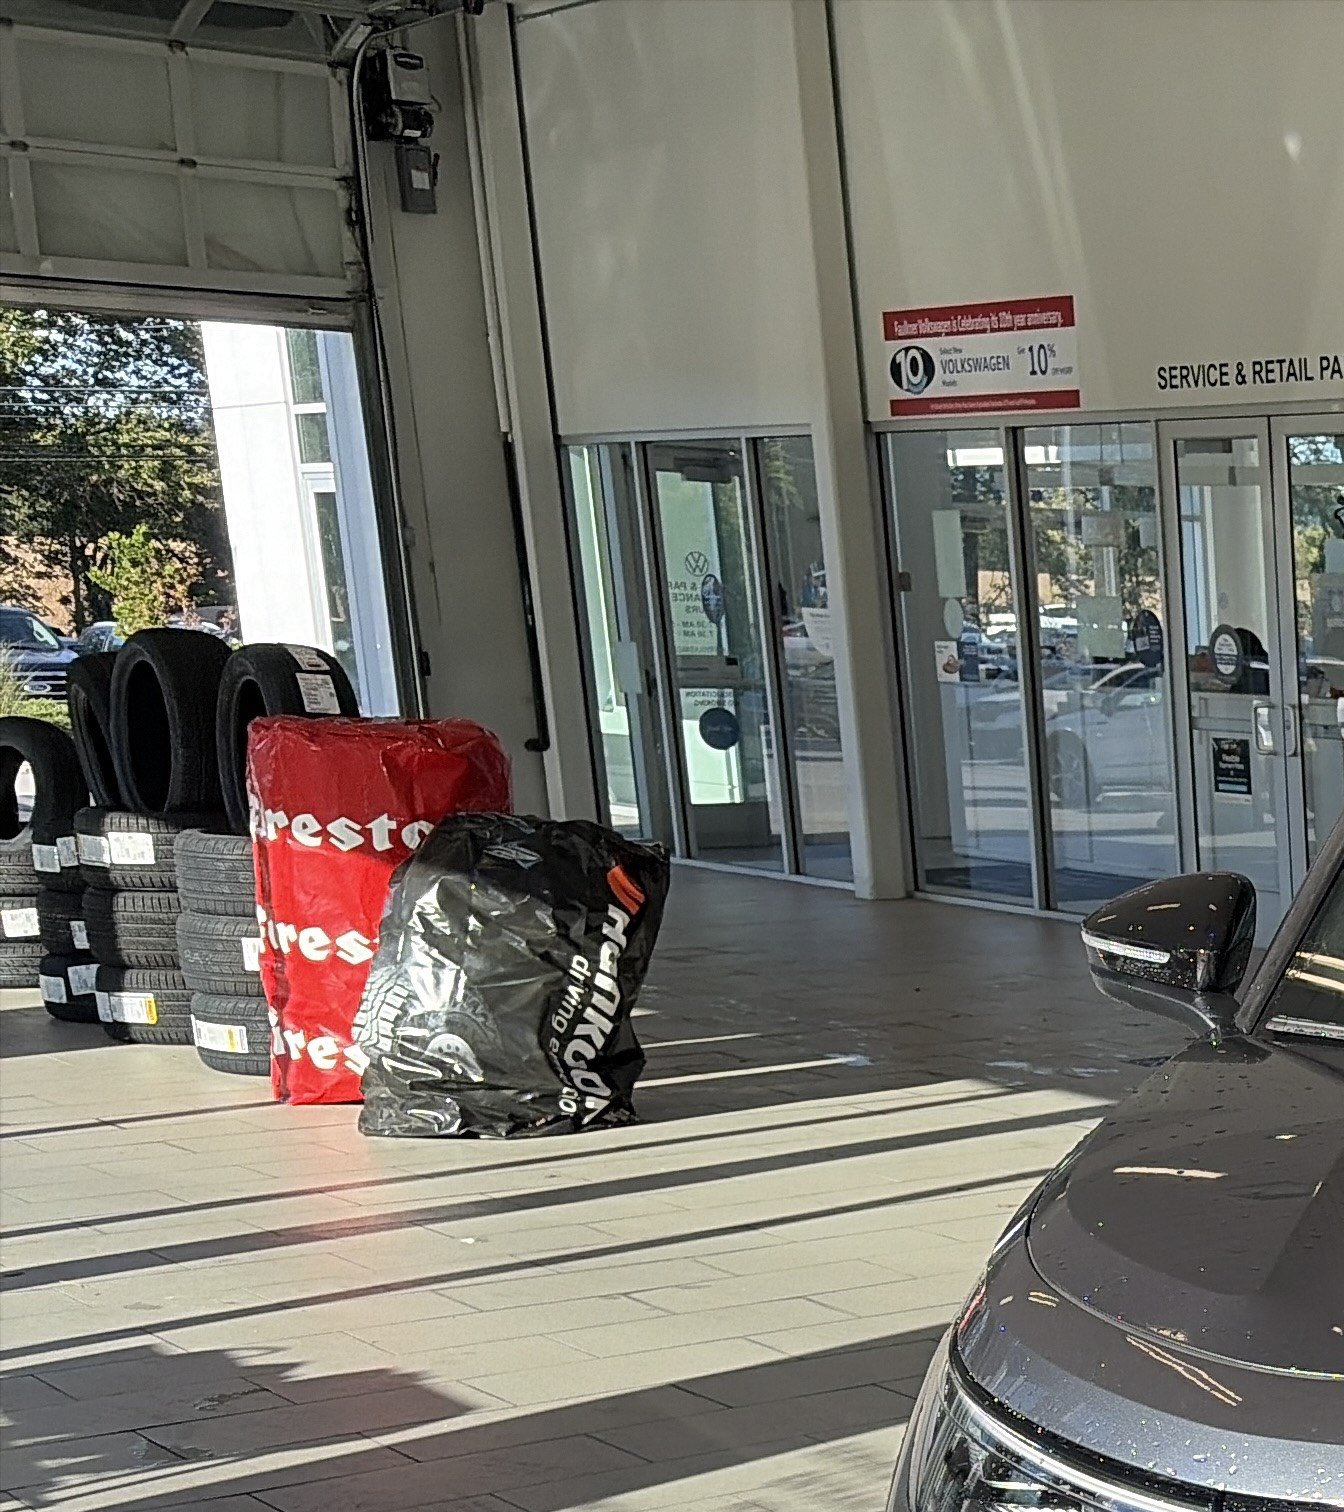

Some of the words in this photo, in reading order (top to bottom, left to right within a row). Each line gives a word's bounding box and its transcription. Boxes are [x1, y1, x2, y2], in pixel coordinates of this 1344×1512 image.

[940, 354, 1011, 375] VOLKSWAGEN
[1157, 362, 1231, 391] SERVICE
[1234, 361, 1248, 386] &
[1251, 357, 1315, 385] RETAIL
[551, 954, 592, 1034] driving
